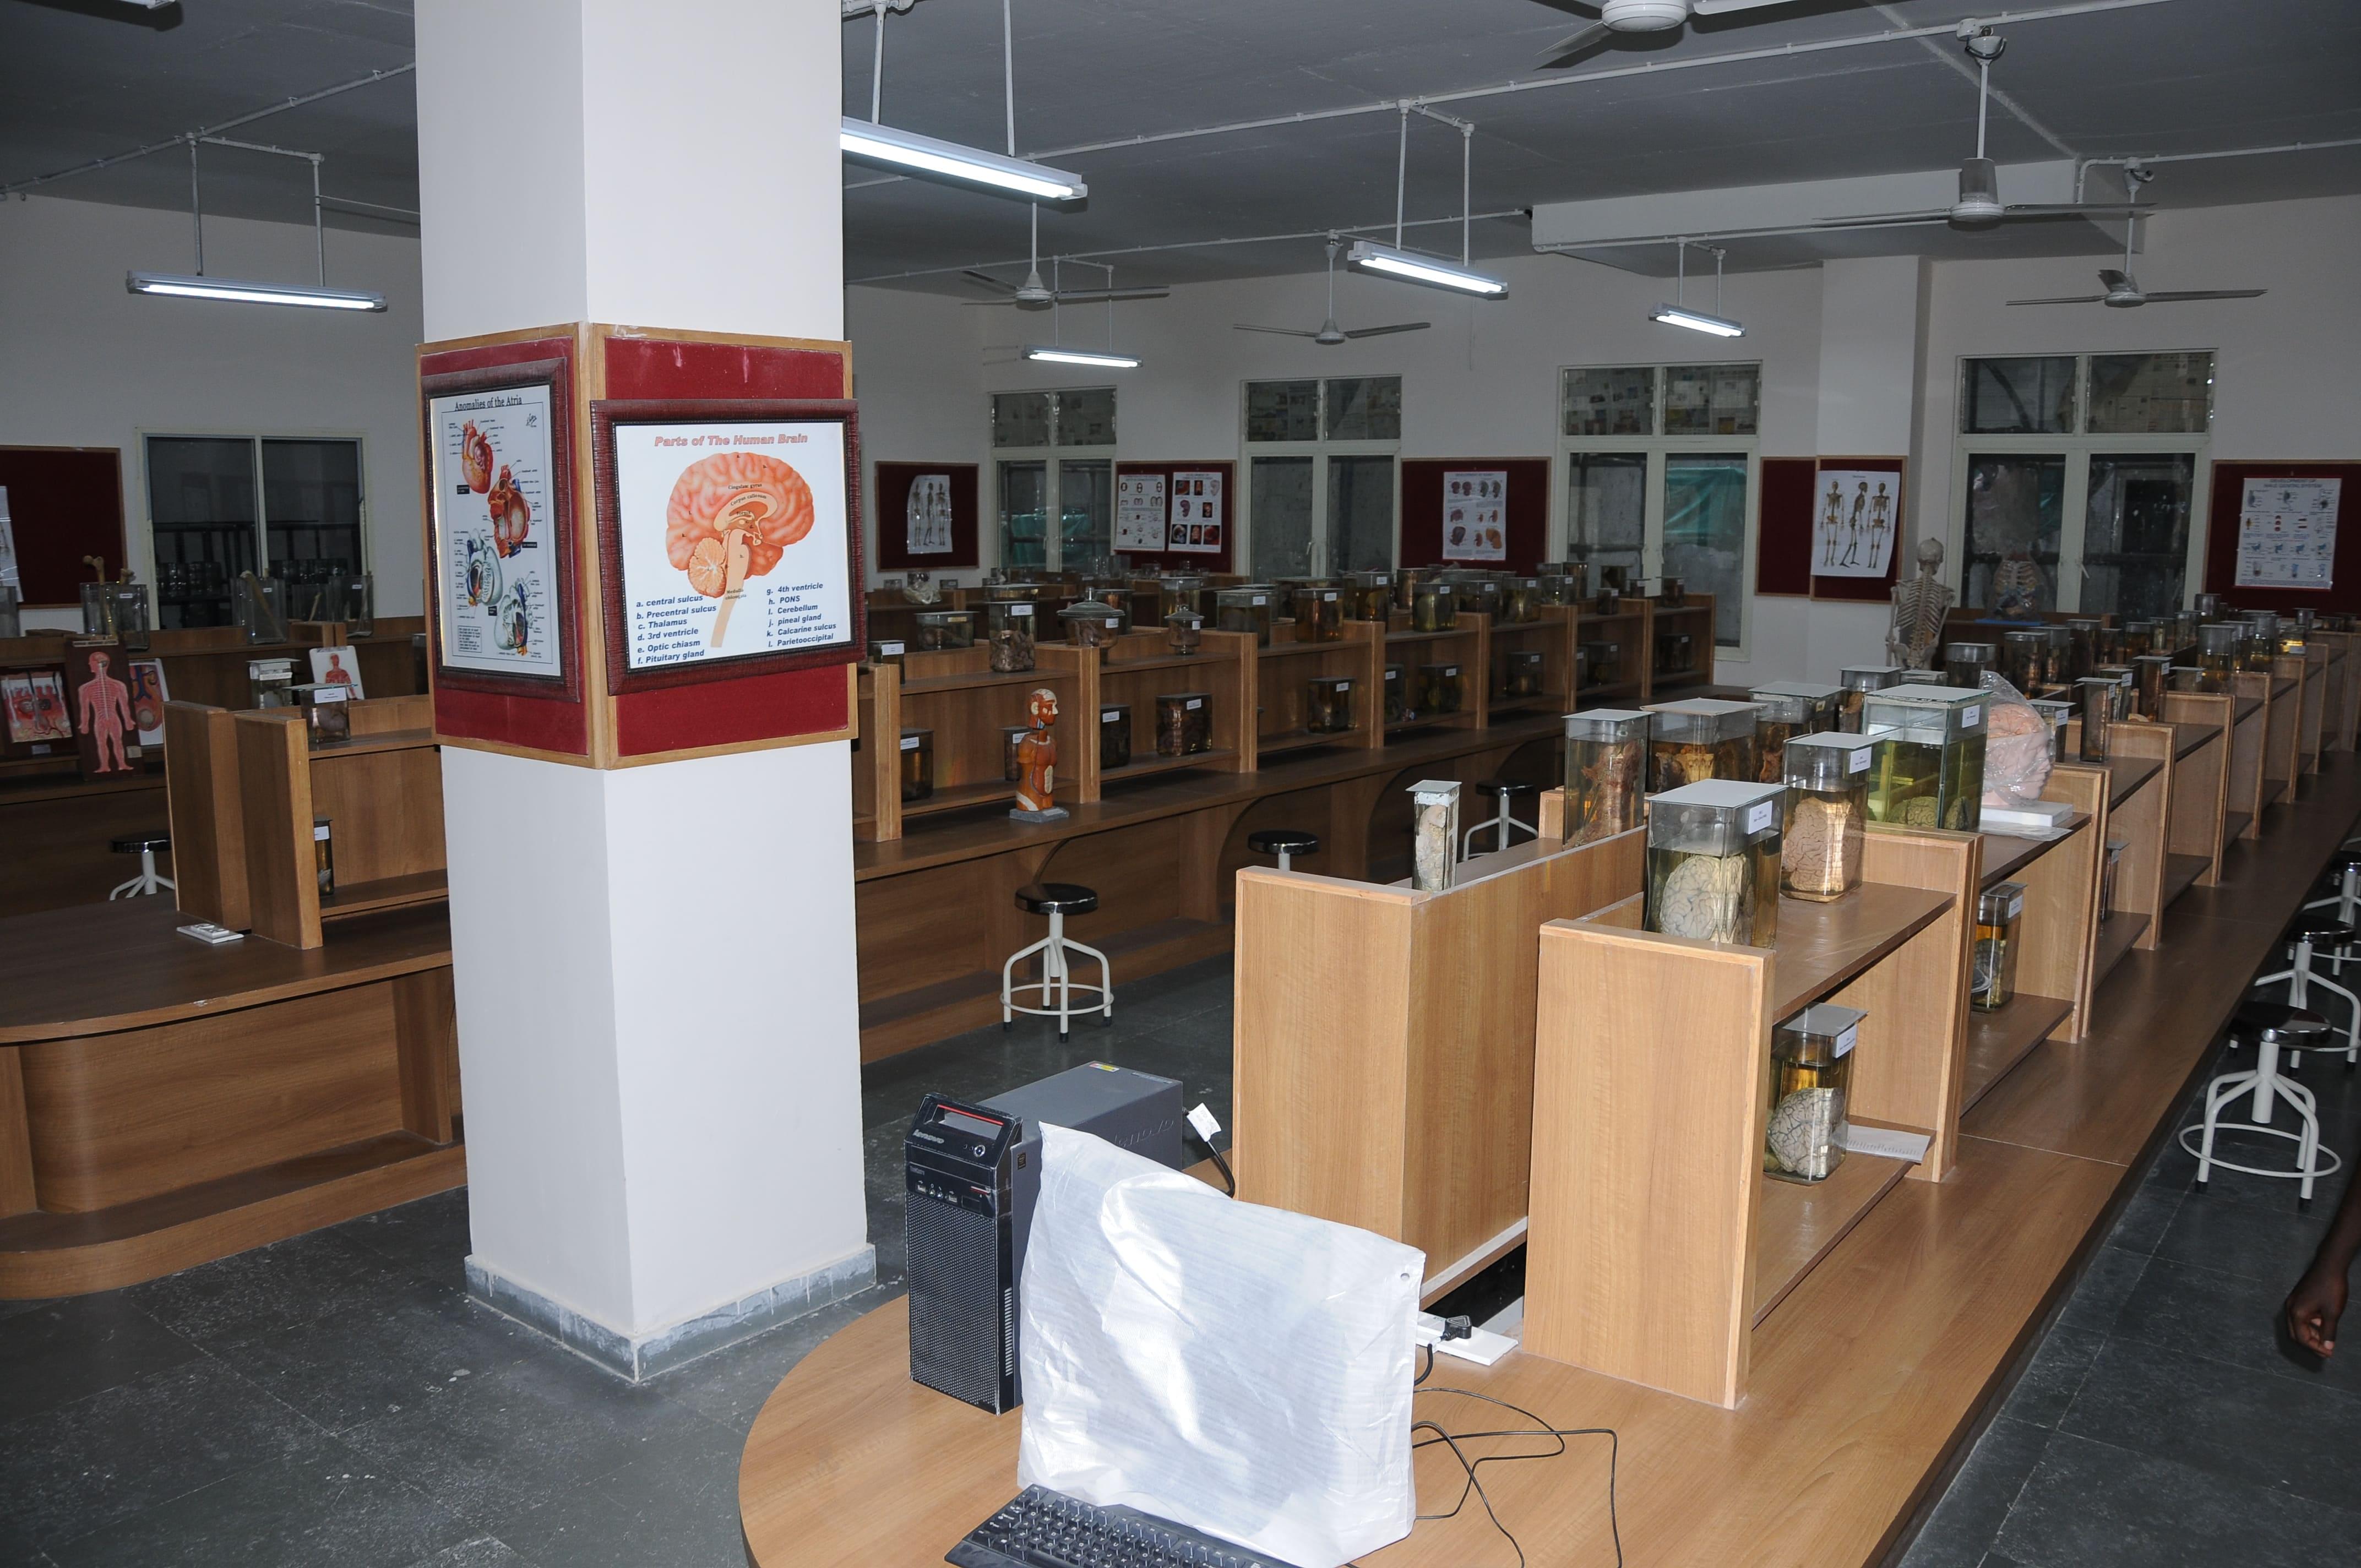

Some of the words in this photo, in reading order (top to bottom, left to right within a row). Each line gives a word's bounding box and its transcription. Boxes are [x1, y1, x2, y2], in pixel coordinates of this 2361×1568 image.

[455, 398, 485, 411] Anomalies
[487, 397, 493, 408] of
[495, 396, 504, 407] the
[507, 394, 522, 406] Atria
[655, 437, 688, 447] Parts
[692, 436, 705, 445] of
[708, 435, 730, 445] The
[733, 435, 774, 445] Human
[778, 434, 808, 443] Brain
[731, 497, 746, 505] Corpus
[792, 582, 823, 591] ventricle
[646, 597, 675, 606] central
[780, 595, 800, 603] PONS
[646, 608, 688, 618] Precentral
[777, 605, 818, 614] Cerebellum
[649, 619, 687, 628] Thalamus
[768, 619, 774, 628] j.
[778, 616, 800, 626] pineal
[802, 613, 822, 623] gland
[648, 631, 661, 640] 3rd
[663, 628, 699, 638] ventricle
[778, 626, 812, 635] Calcarine
[777, 633, 834, 646] Parietooccipital
[648, 643, 669, 652] Optic
[672, 640, 700, 649] chiasm
[646, 654, 680, 663] Pituitary
[683, 650, 705, 660] gland
[912, 1129, 945, 1144] lenovo
